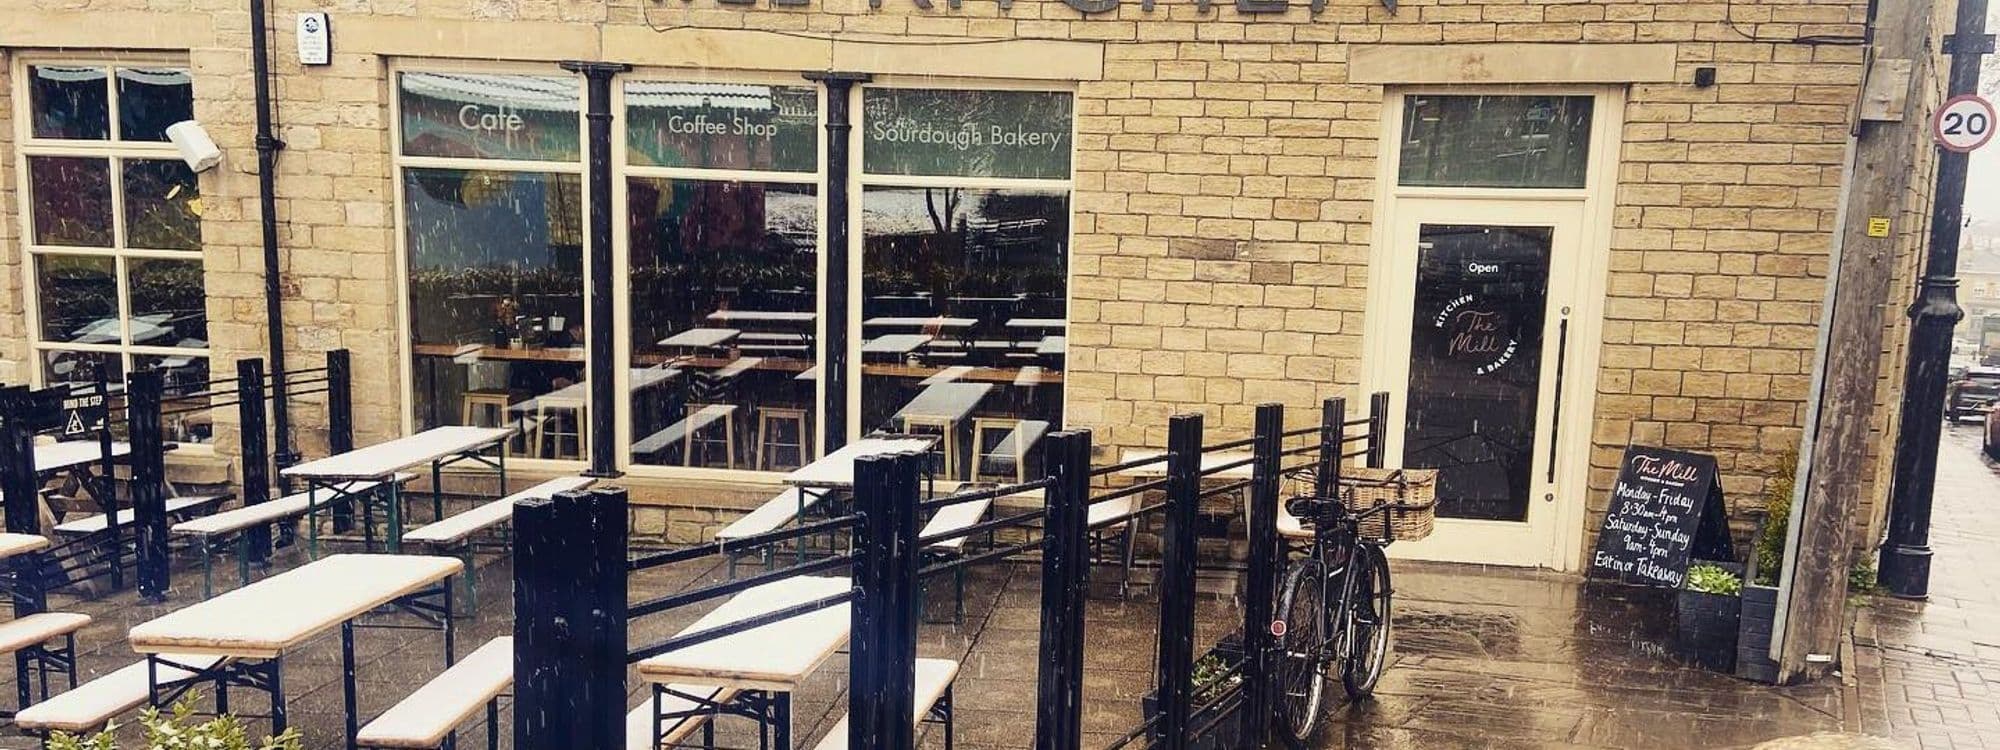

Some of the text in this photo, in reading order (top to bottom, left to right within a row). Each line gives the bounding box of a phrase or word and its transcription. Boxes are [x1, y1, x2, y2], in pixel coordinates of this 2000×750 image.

[668, 115, 777, 140] Coffee Shop
[872, 121, 1061, 151] Sourdough Bakery
[1944, 112, 1987, 135] 20
[1468, 262, 1499, 275] Open
[1435, 294, 1473, 328] KITCHEN
[1456, 310, 1496, 333] The
[1449, 332, 1500, 356] Mill
[1487, 339, 1518, 373] BAKERY
[1631, 454, 1660, 474] The
[1658, 460, 1698, 482] Mill
[1636, 557, 1683, 588] Takeaway
